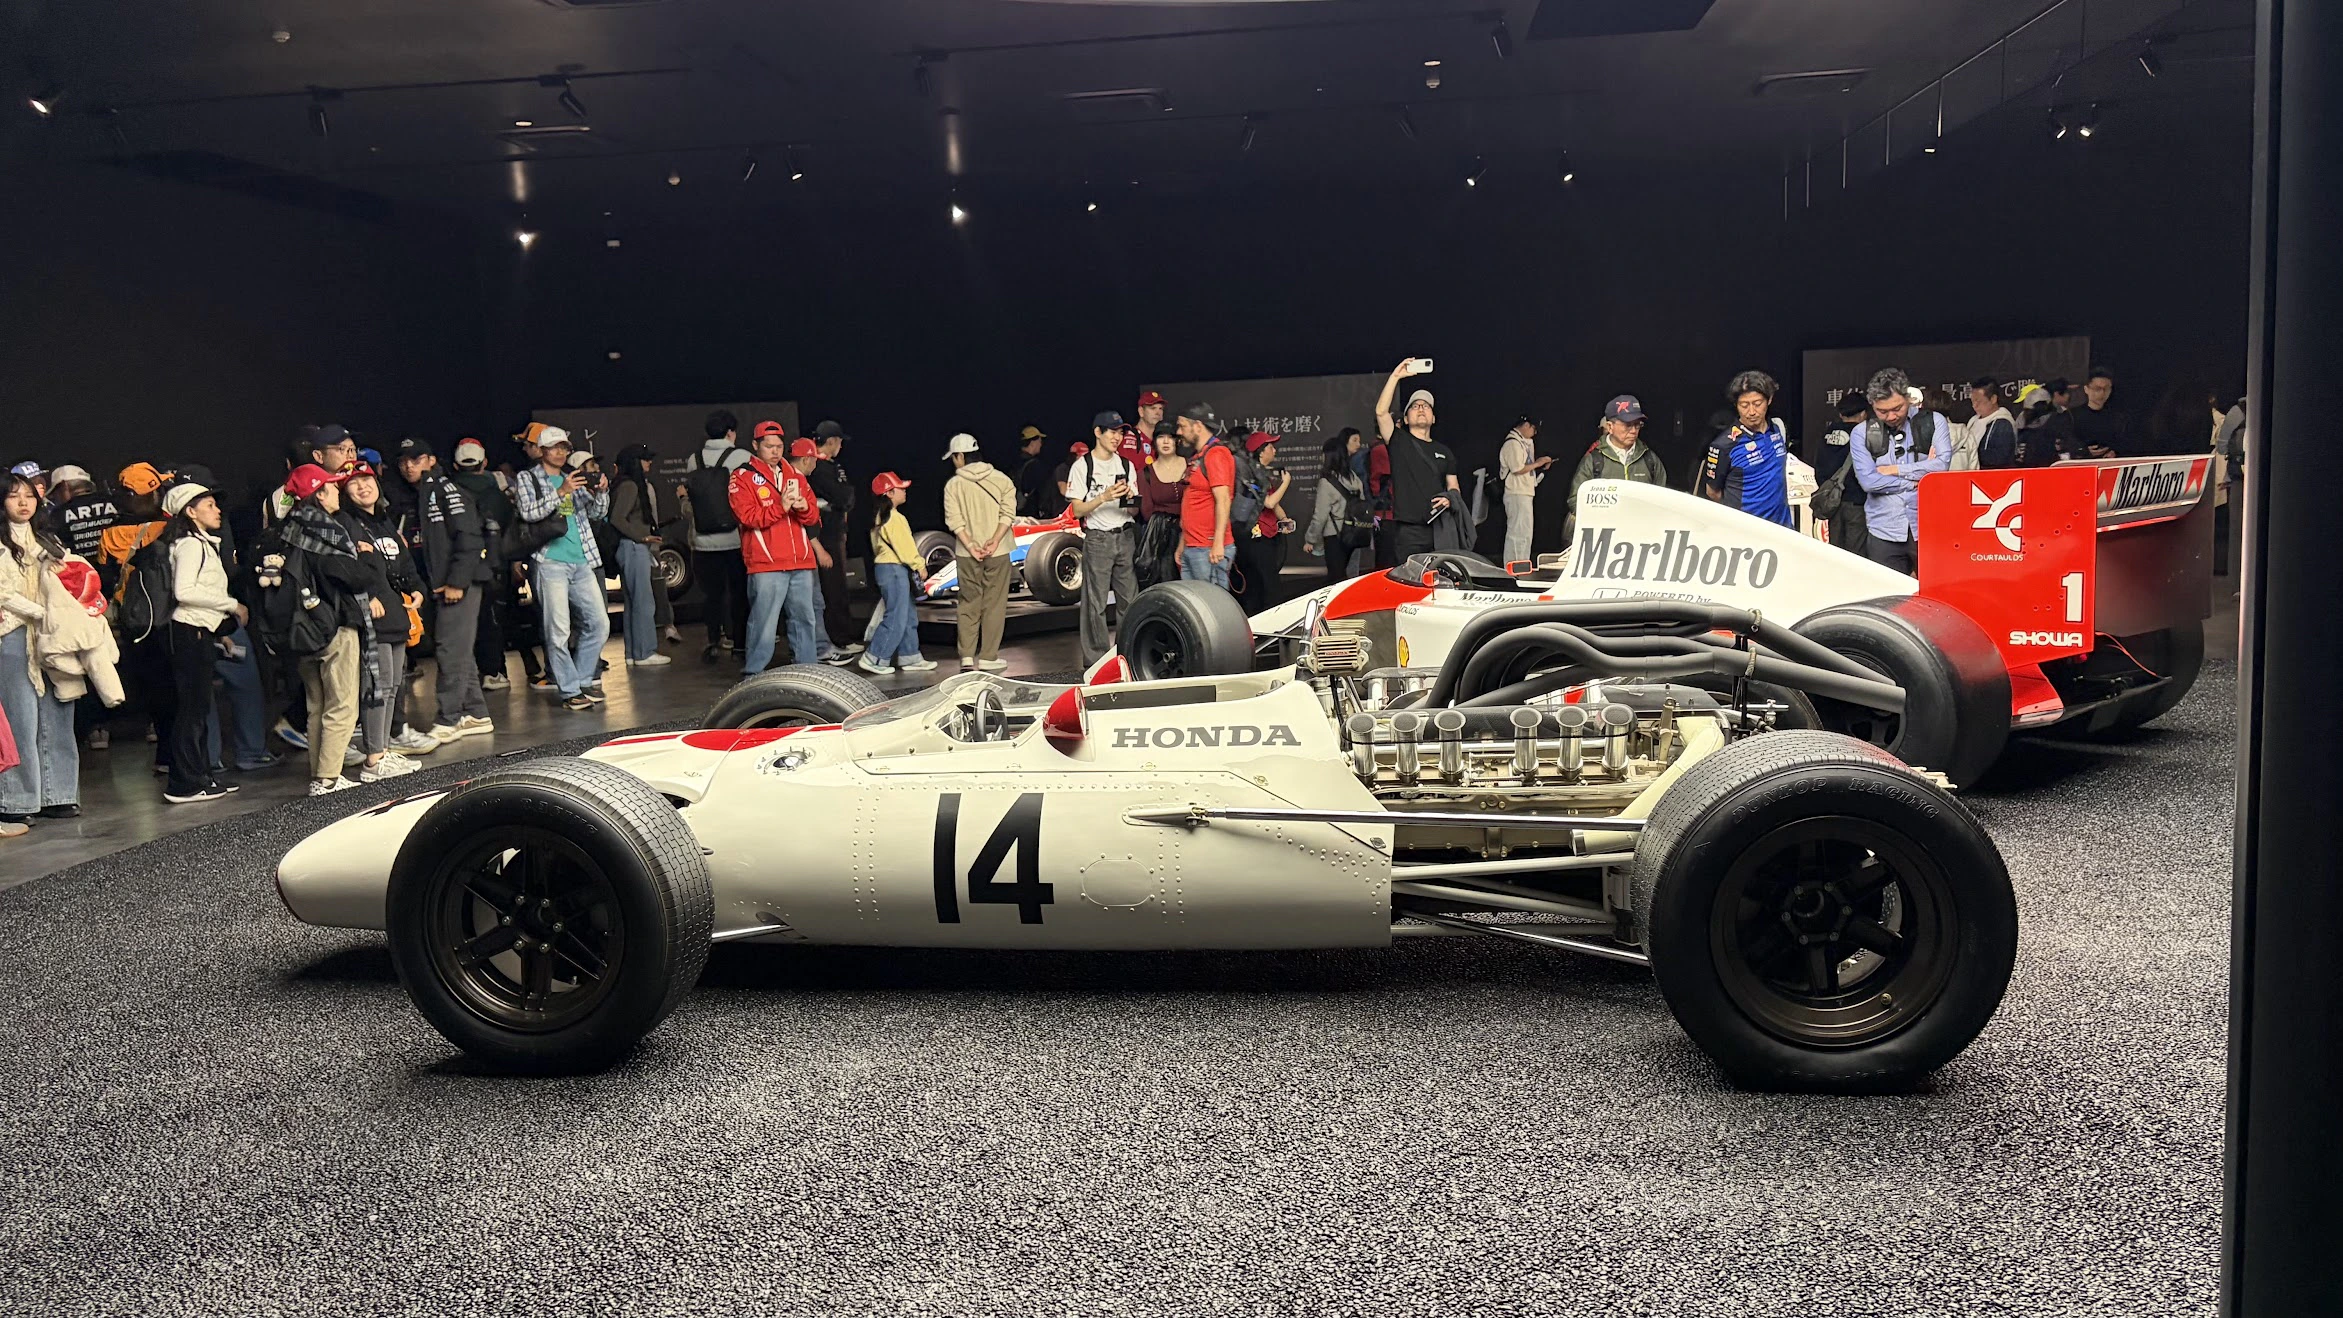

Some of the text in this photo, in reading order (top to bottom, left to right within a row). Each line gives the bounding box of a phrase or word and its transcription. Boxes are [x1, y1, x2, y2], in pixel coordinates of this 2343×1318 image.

[1585, 493, 1618, 505] BOSS
[2111, 463, 2184, 510] Marlboro
[65, 502, 118, 523] ARTA
[1571, 527, 1779, 589] Marlboro
[1970, 552, 2025, 562] COURTAULDS
[2061, 572, 2084, 622] 1
[2009, 631, 2083, 648] SHOWA
[1112, 724, 1302, 749] HONDA
[1731, 777, 1828, 825] DUNLOP
[933, 793, 1055, 925] 14
